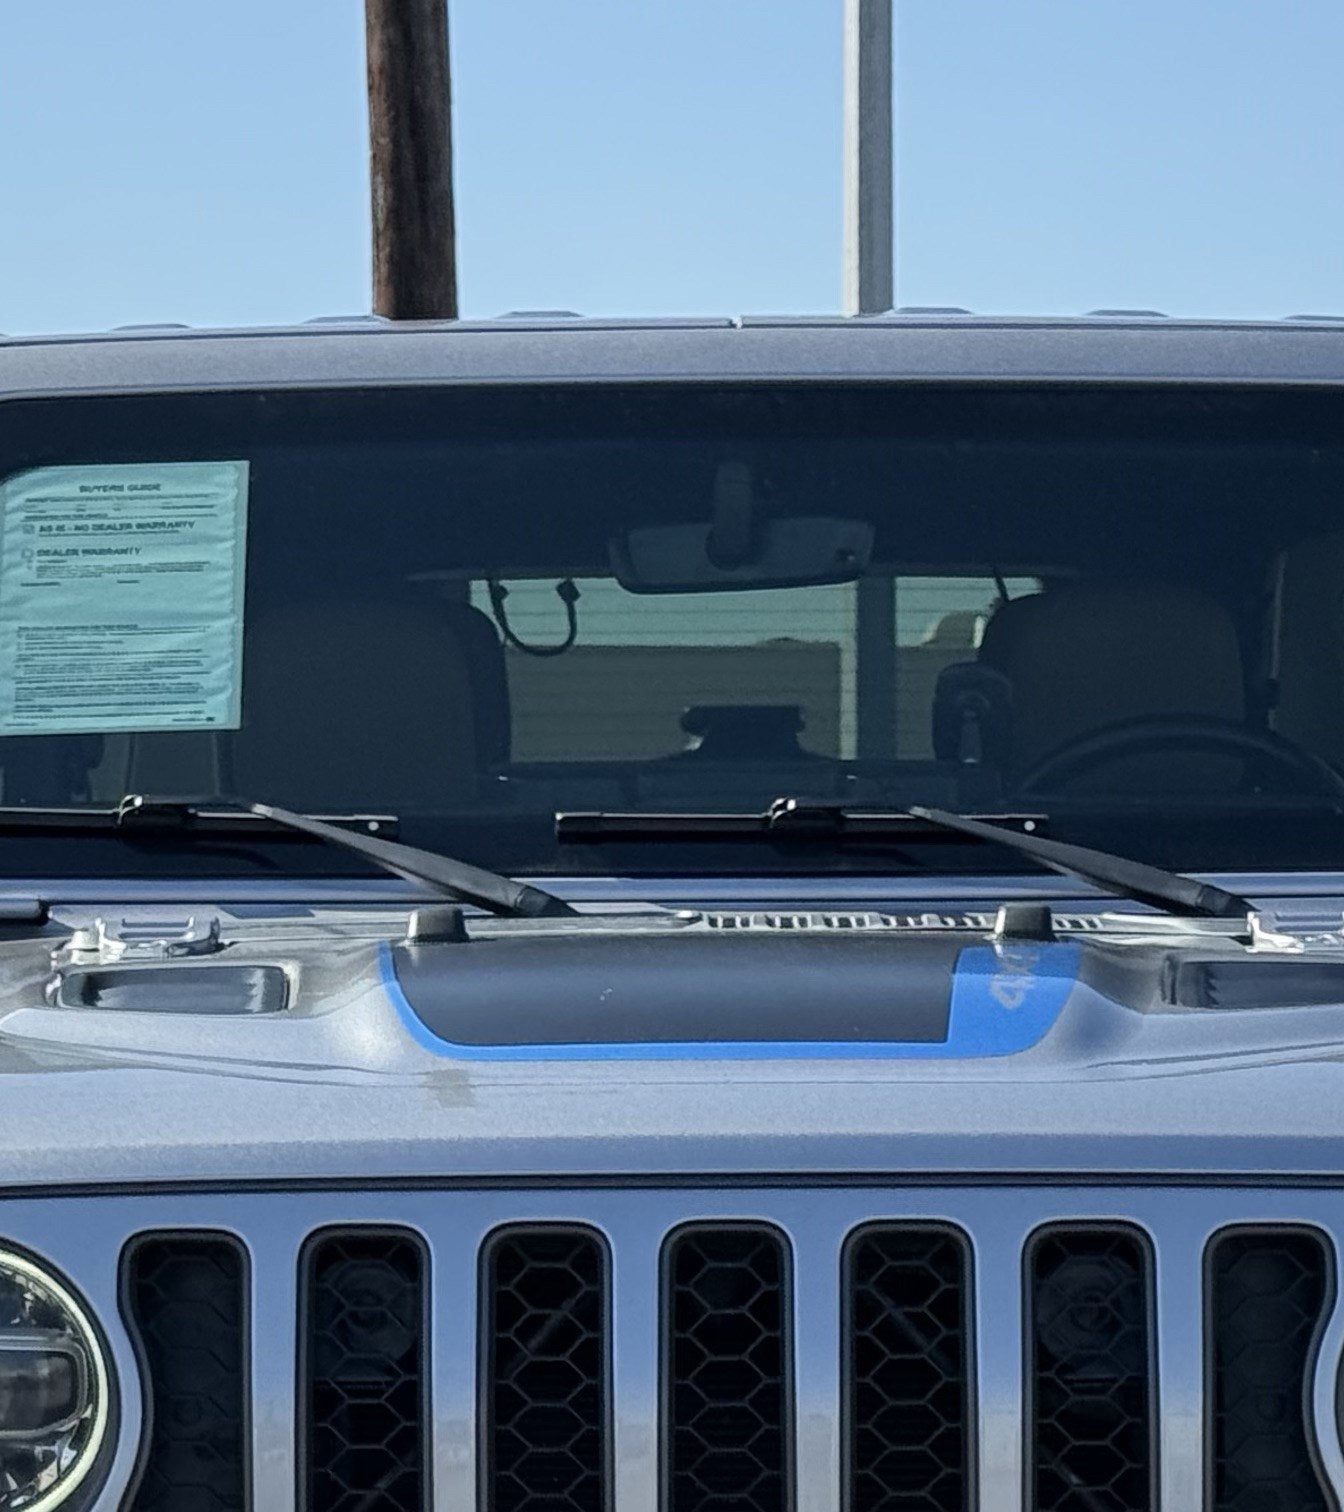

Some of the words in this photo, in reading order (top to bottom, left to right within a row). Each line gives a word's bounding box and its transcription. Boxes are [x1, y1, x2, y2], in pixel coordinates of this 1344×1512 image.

[91, 522, 133, 531] DEALER
[135, 521, 195, 530] WARRANTY
[37, 548, 79, 557] DEALER
[81, 547, 141, 556] WARRANTY
